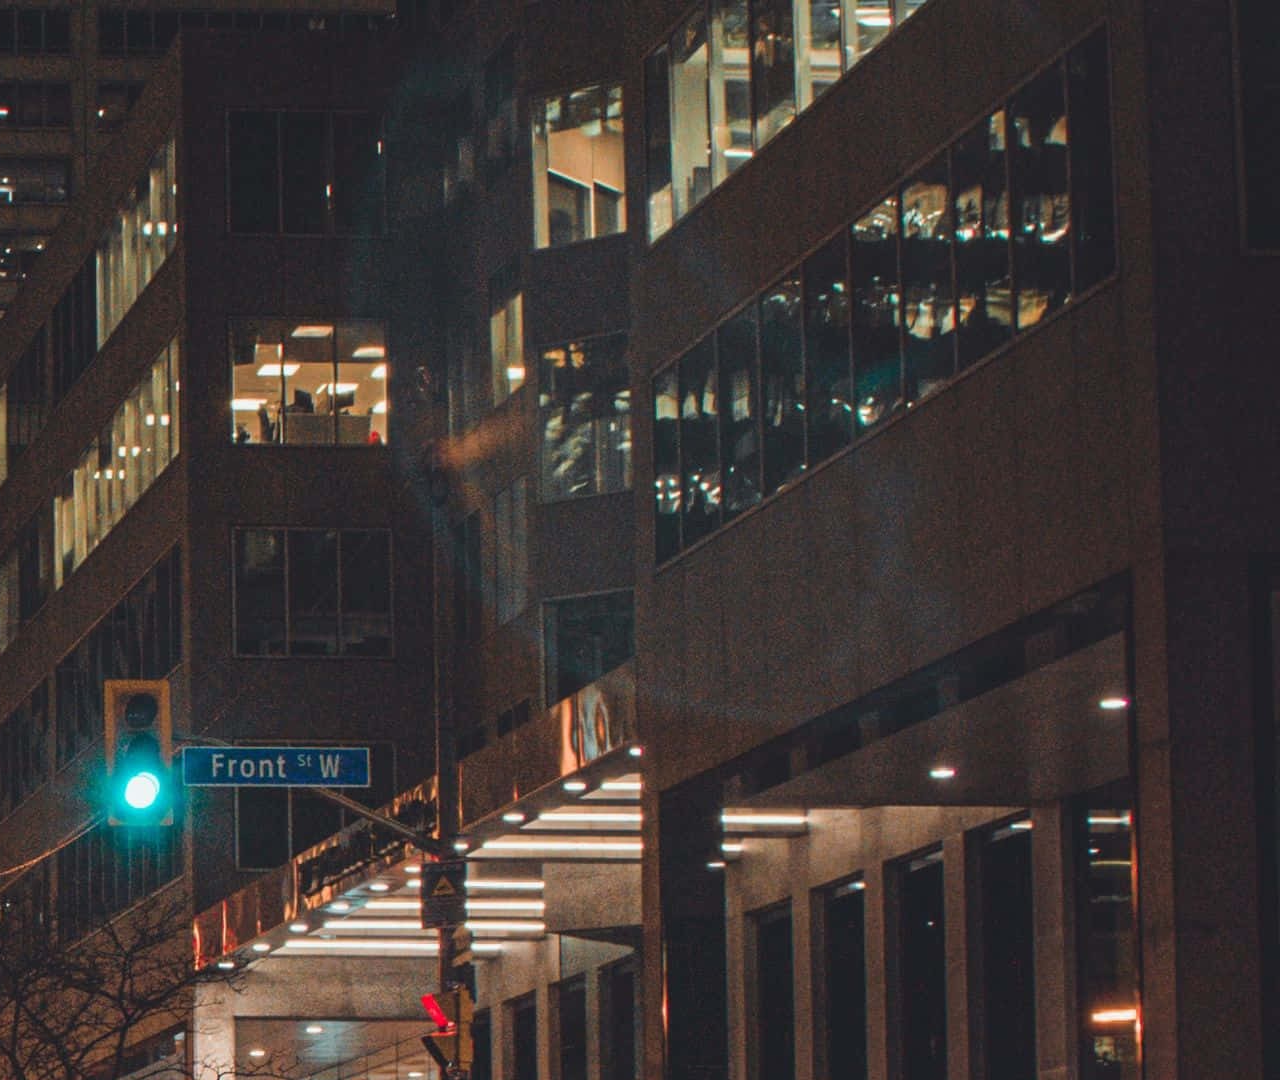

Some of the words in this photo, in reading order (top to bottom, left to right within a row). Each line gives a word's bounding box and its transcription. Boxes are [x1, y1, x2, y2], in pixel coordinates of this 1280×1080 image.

[211, 754, 287, 778] Front
[297, 754, 312, 767] St
[320, 754, 341, 778] W
